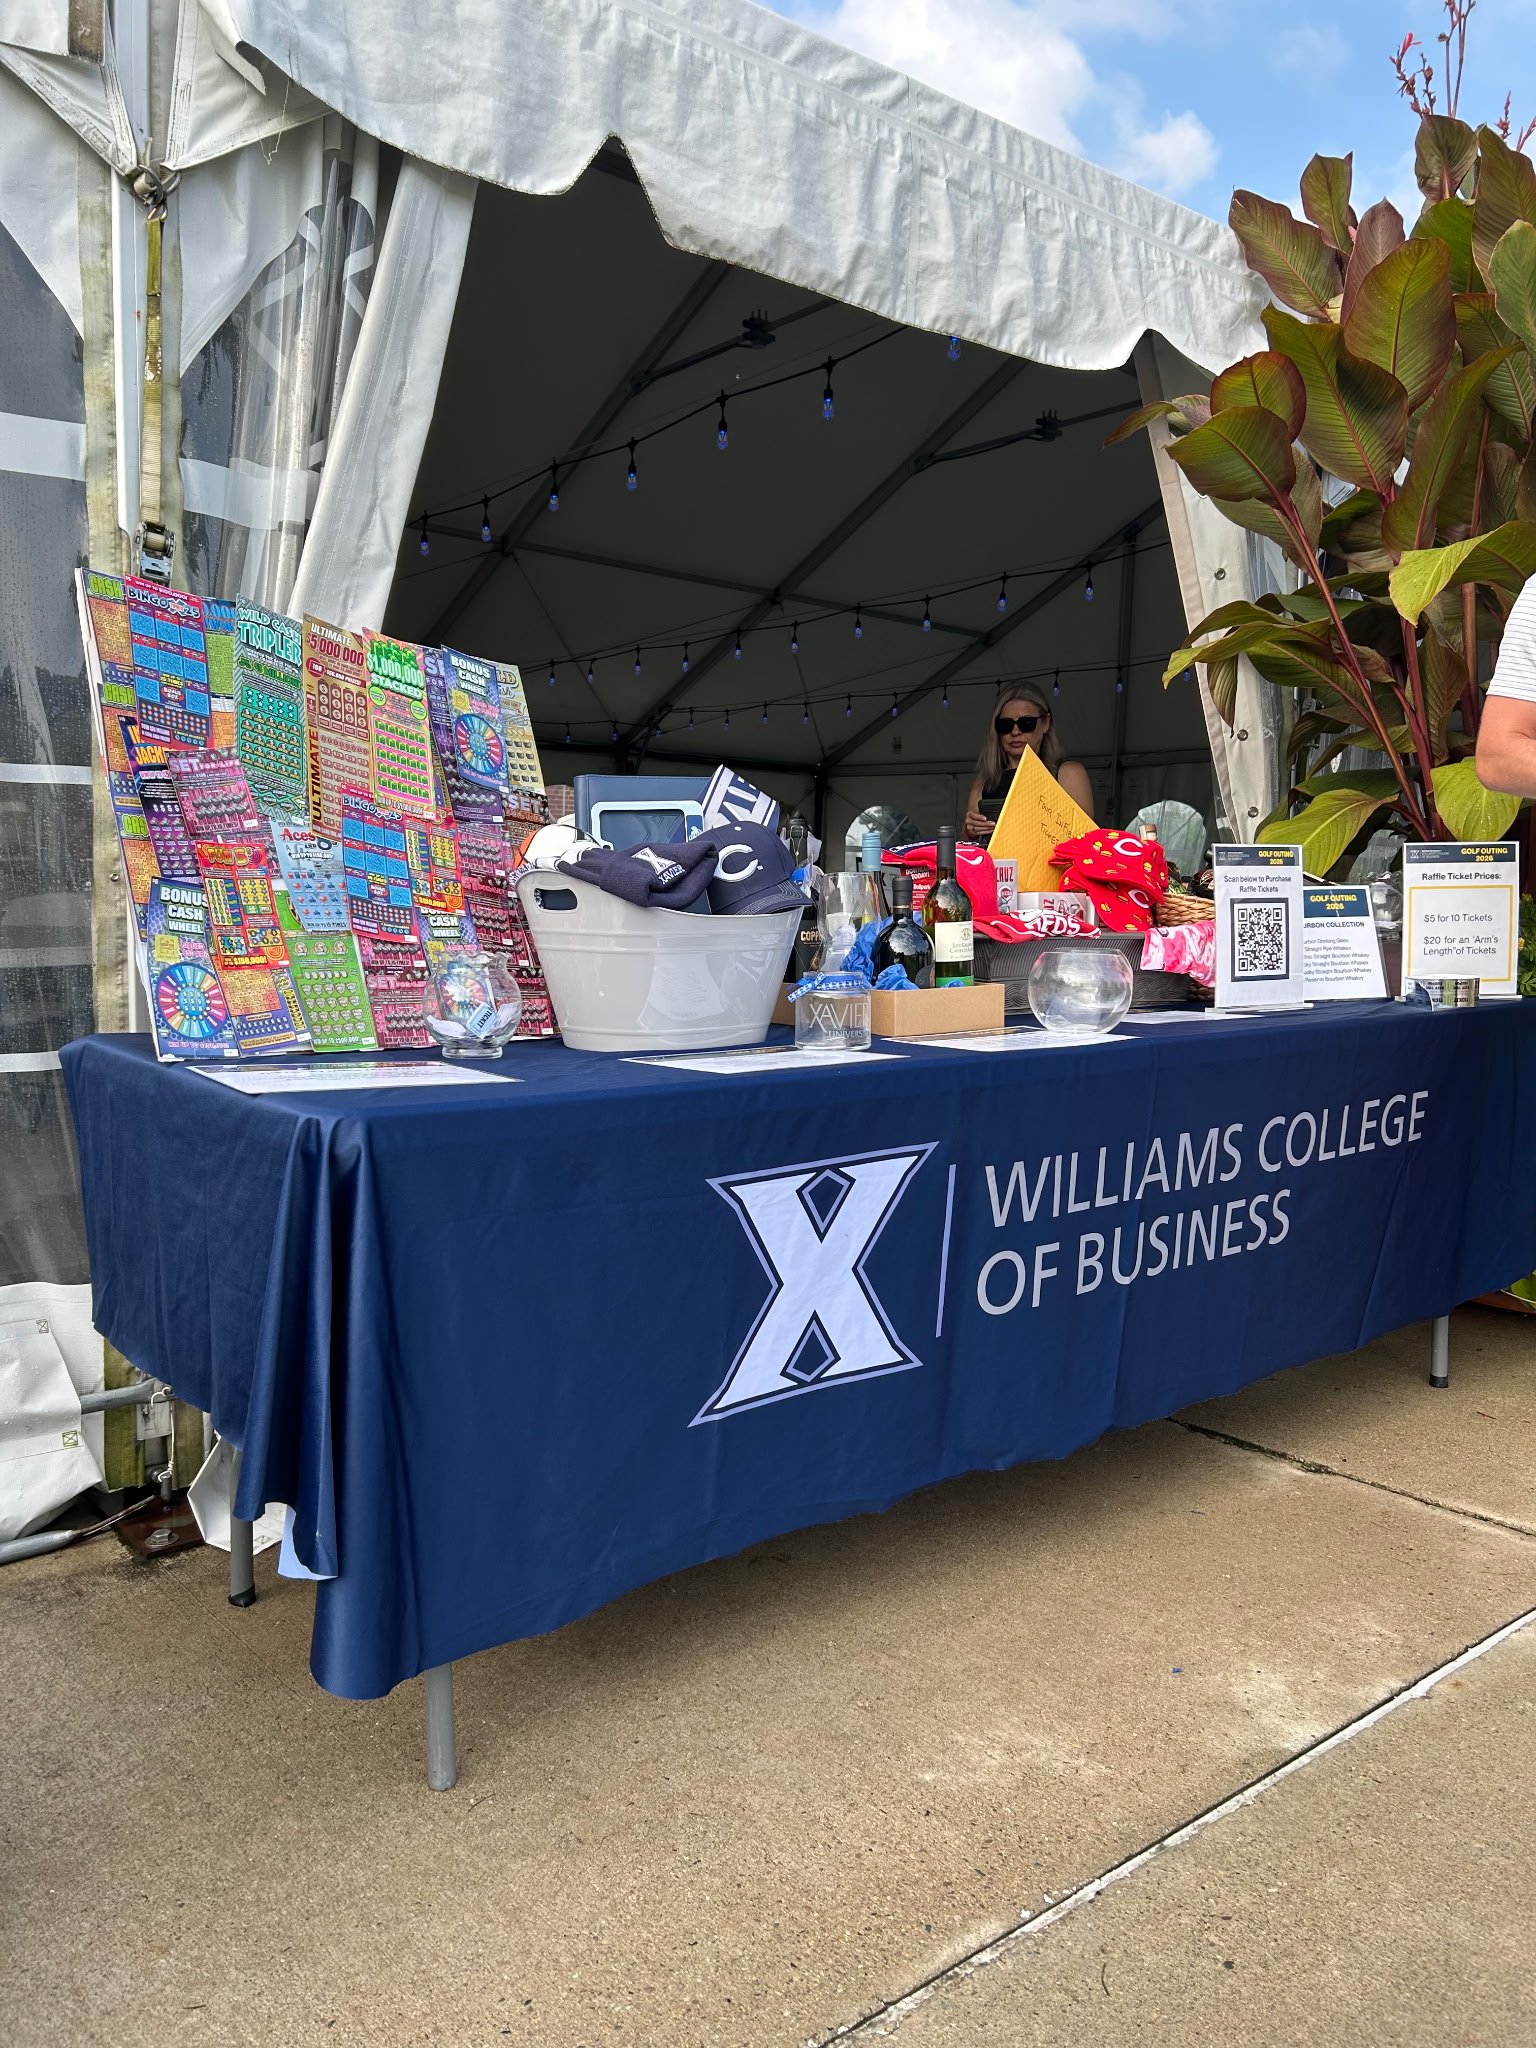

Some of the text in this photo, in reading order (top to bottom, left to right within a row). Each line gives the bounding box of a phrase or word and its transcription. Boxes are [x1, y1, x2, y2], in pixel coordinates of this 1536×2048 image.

[127, 585, 168, 608] BINGO
[238, 608, 270, 625] WILD
[271, 619, 302, 646] CASH
[311, 622, 352, 647] ULTIMATE
[238, 621, 302, 667] TRIPLER
[306, 632, 365, 667] $5,000,000
[450, 655, 491, 679] BONUS
[370, 671, 423, 700] STACKED
[458, 670, 486, 687] CASH
[460, 680, 486, 697] WHEEL
[135, 745, 168, 765] JACK
[168, 758, 199, 772] SET
[308, 728, 322, 821] ULTIMATE
[342, 793, 376, 813] BINGO
[508, 794, 541, 814] SET
[122, 814, 147, 835] CAS
[280, 828, 317, 841] Aces
[207, 846, 234, 865] FUN
[1113, 838, 1143, 857] C
[1258, 850, 1273, 858] GOLF
[1273, 850, 1294, 858] OUTING
[1461, 847, 1508, 855] GOLF OUTING
[713, 843, 759, 882] C
[657, 864, 686, 885] XAVIER
[1224, 875, 1239, 883] Scan
[1239, 875, 1258, 883] below
[1265, 875, 1291, 883] Purchase
[1422, 872, 1502, 881] Raffle Ticket Prices:
[160, 886, 208, 907] BONUS
[1239, 885, 1279, 893] Raffle Tickets
[1330, 894, 1357, 902] OUTING
[1128, 889, 1150, 909] C
[1326, 902, 1344, 910] 2026
[168, 904, 203, 921] CASH
[1423, 913, 1493, 923] $5 for 10 Tickets
[168, 920, 204, 934] WHEEL
[429, 916, 460, 928] CASH
[432, 929, 461, 938] WHEEL
[1423, 936, 1441, 945] $20
[1444, 935, 1456, 944] for
[1466, 946, 1497, 954] Tickets
[366, 975, 397, 989] SET
[476, 1010, 493, 1028] TICKET
[808, 1002, 869, 1033] XAVIER
[828, 1029, 869, 1039] UNIVERS
[984, 1090, 1429, 1228] WILLIAMS COLLEGE
[976, 1188, 1292, 1316] OF BUSINESS
